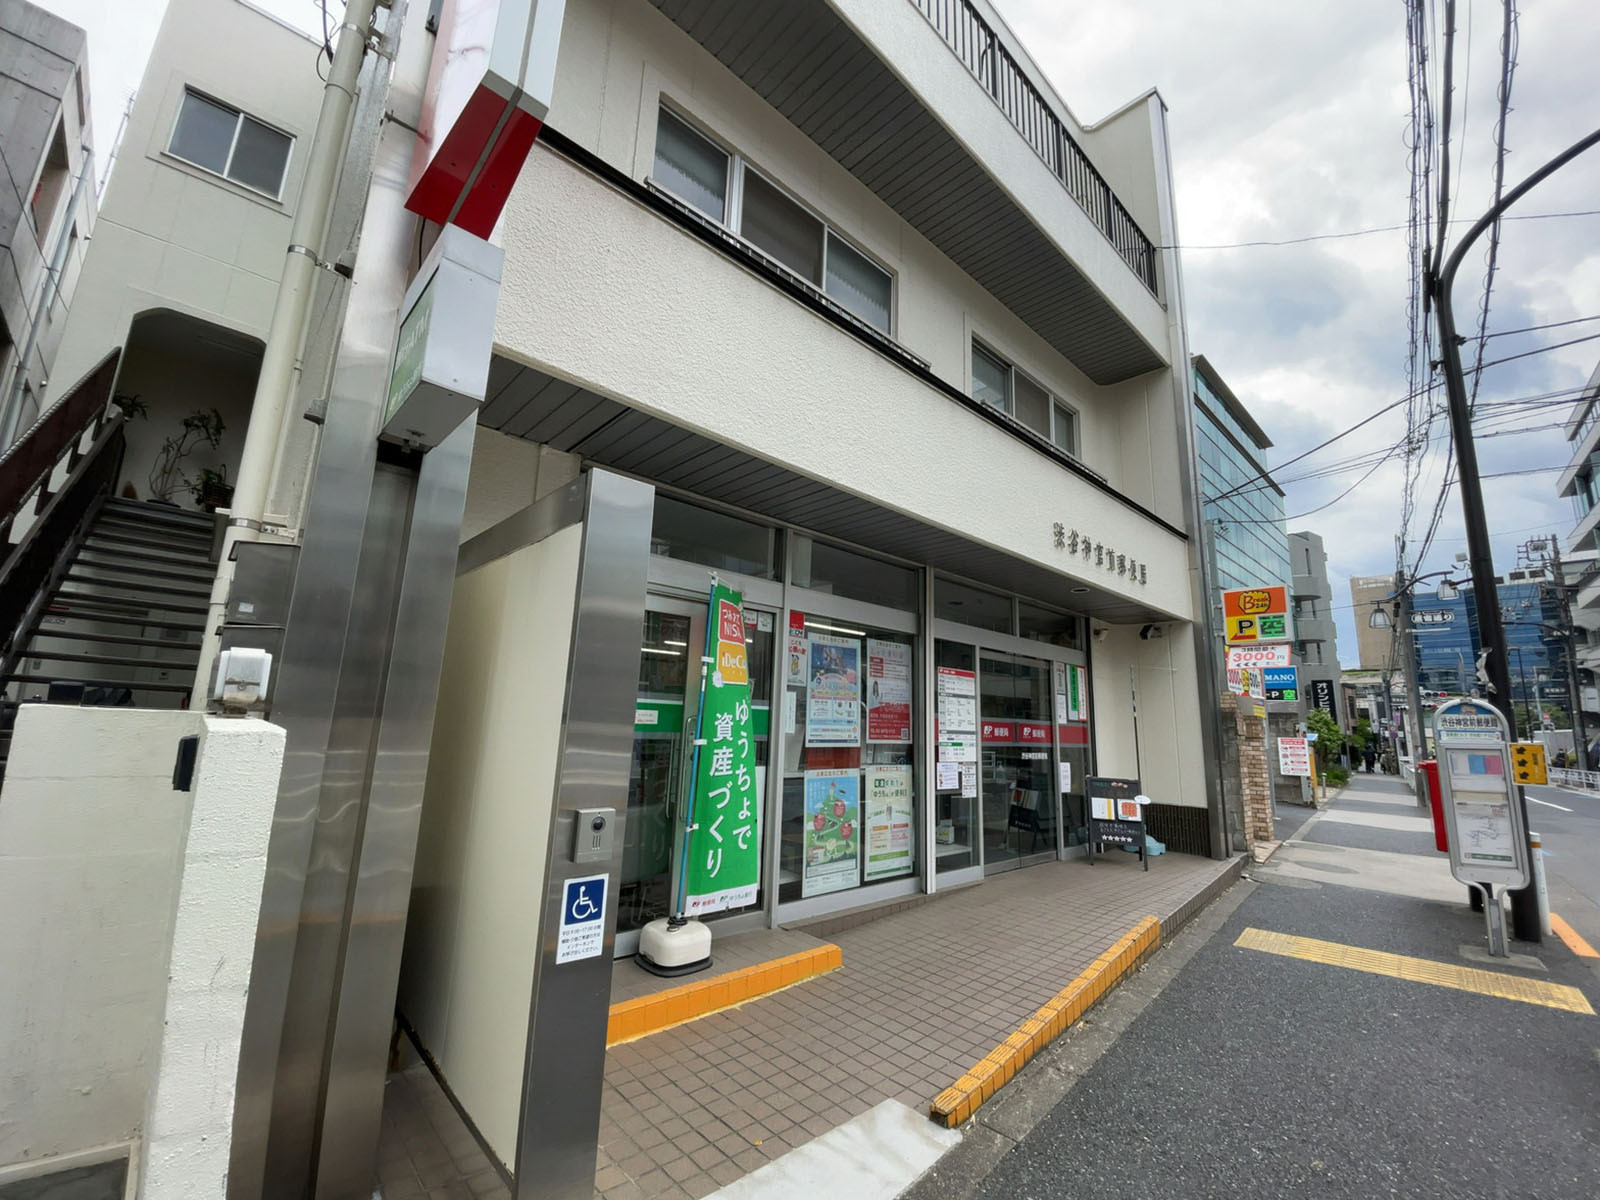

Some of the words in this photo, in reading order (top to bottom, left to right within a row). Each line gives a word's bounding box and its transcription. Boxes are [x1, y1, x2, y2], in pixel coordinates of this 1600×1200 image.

[1238, 619, 1254, 634] P
[1271, 691, 1279, 699] P
[706, 712, 734, 879] 資産づくり
[733, 699, 751, 849] ゆうちょで
